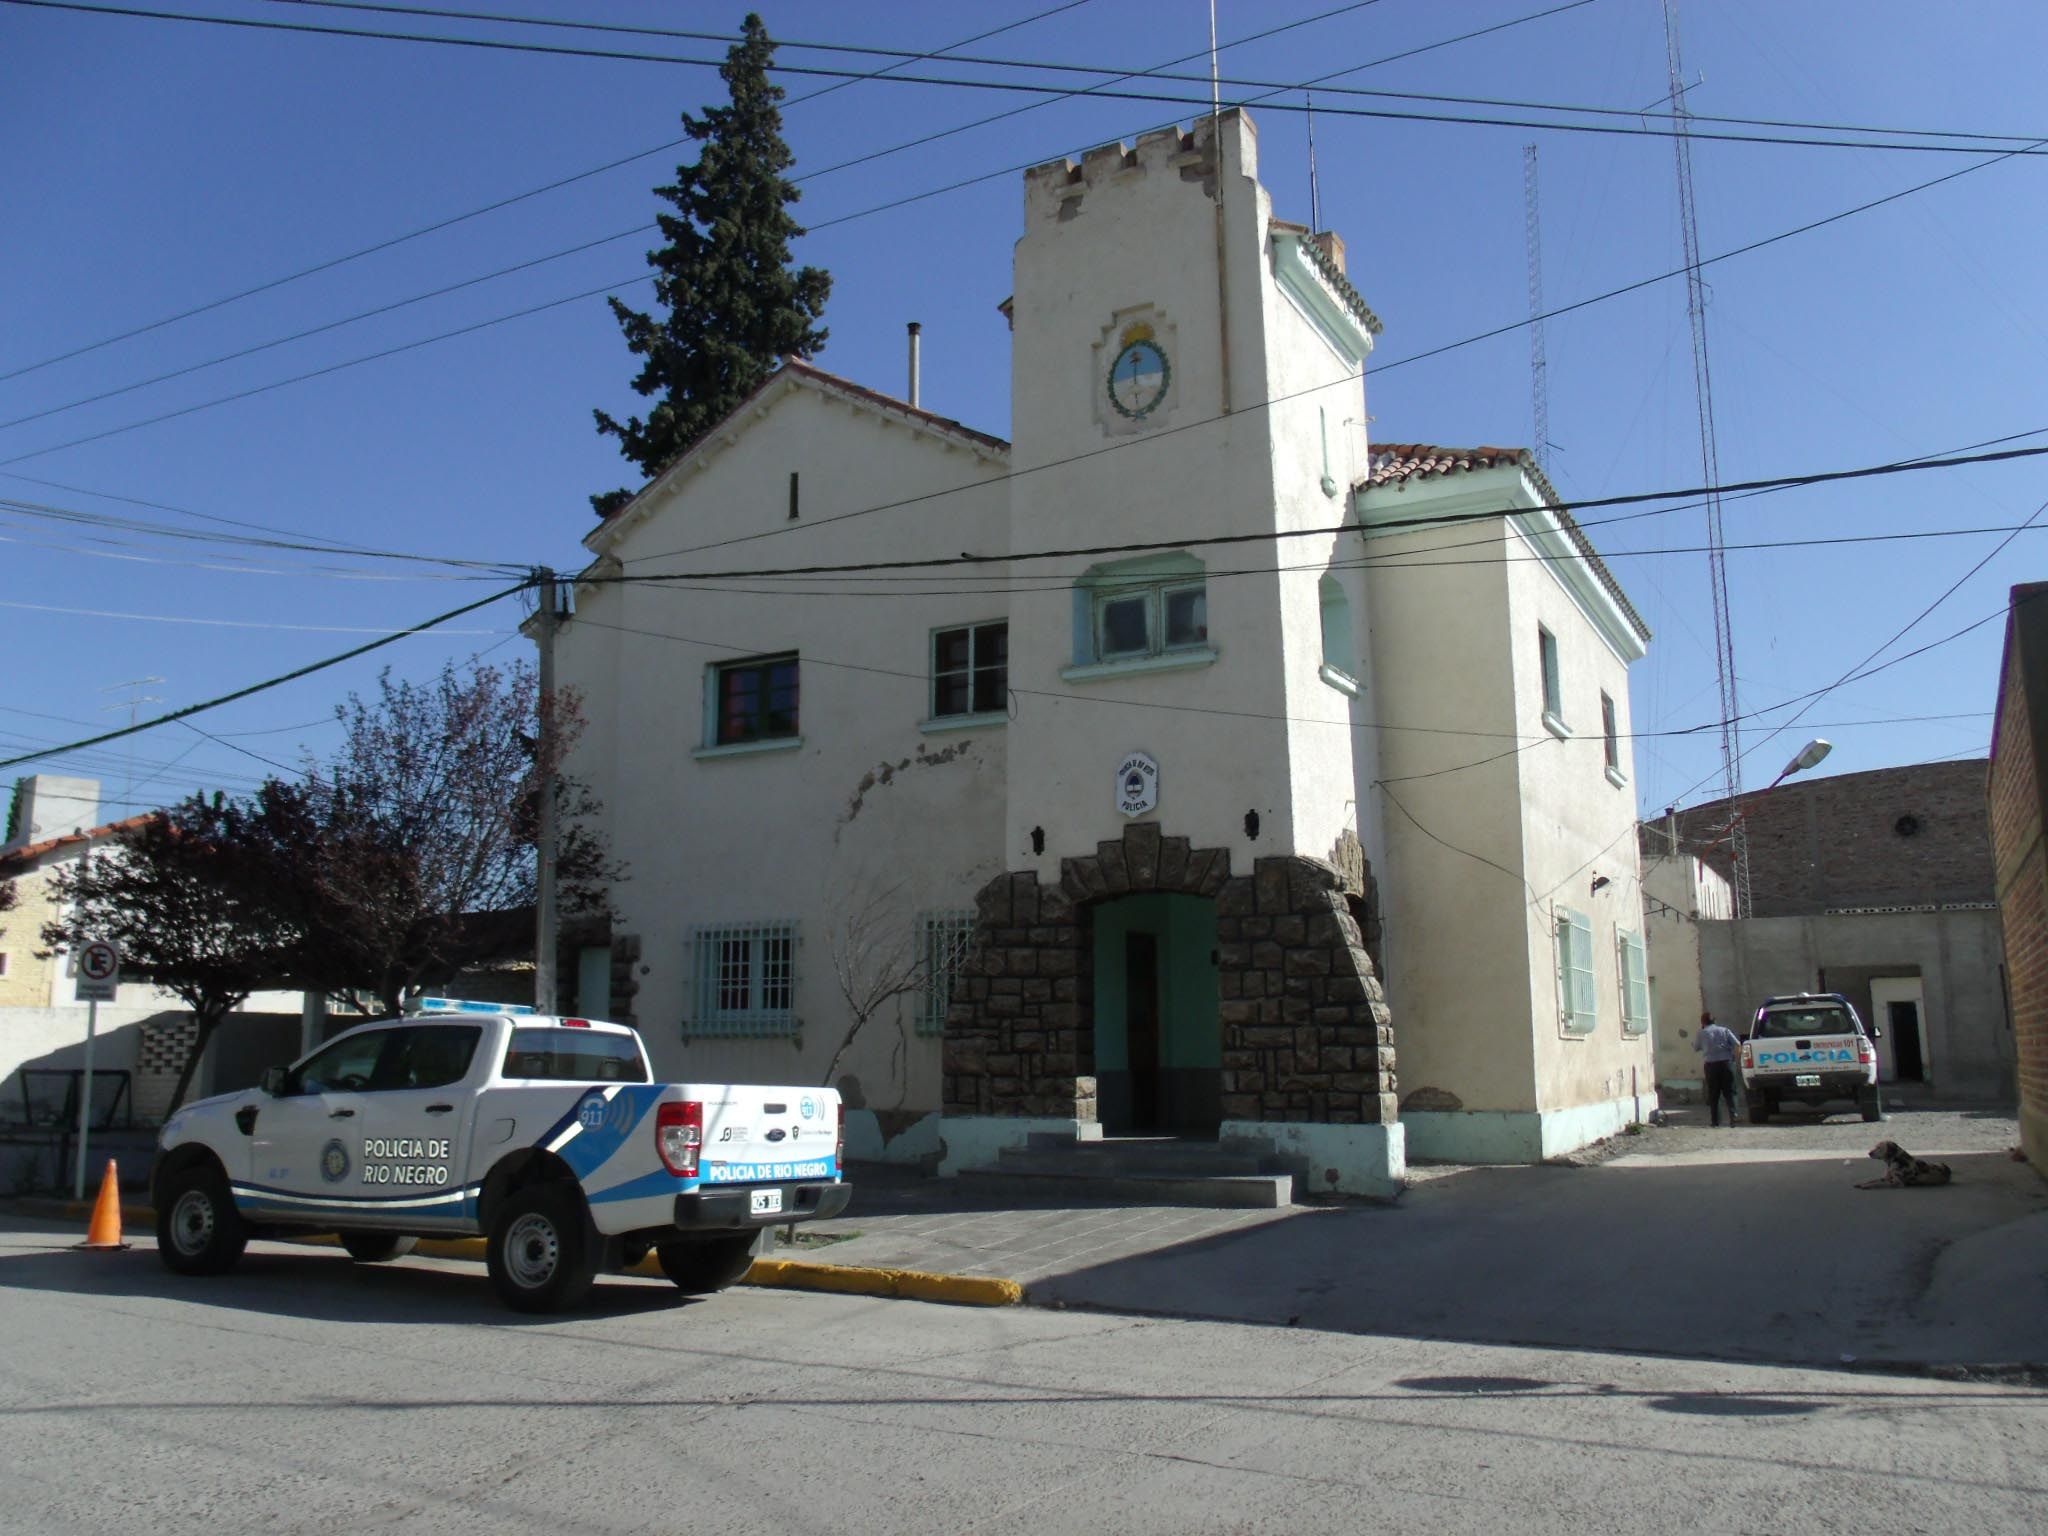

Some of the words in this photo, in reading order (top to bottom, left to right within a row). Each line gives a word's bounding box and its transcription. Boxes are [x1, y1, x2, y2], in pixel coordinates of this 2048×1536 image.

[1122, 800, 1148, 811] POLICIA
[581, 1110, 603, 1126] 911
[364, 1139, 425, 1159] POLICIA
[428, 1139, 449, 1158] DE
[363, 1164, 390, 1184] RIO
[393, 1165, 448, 1185] NEGRO
[710, 1165, 755, 1181] POLICIA
[758, 1164, 772, 1179] DE
[774, 1163, 792, 1178] RIO
[794, 1162, 828, 1178] NEGRO
